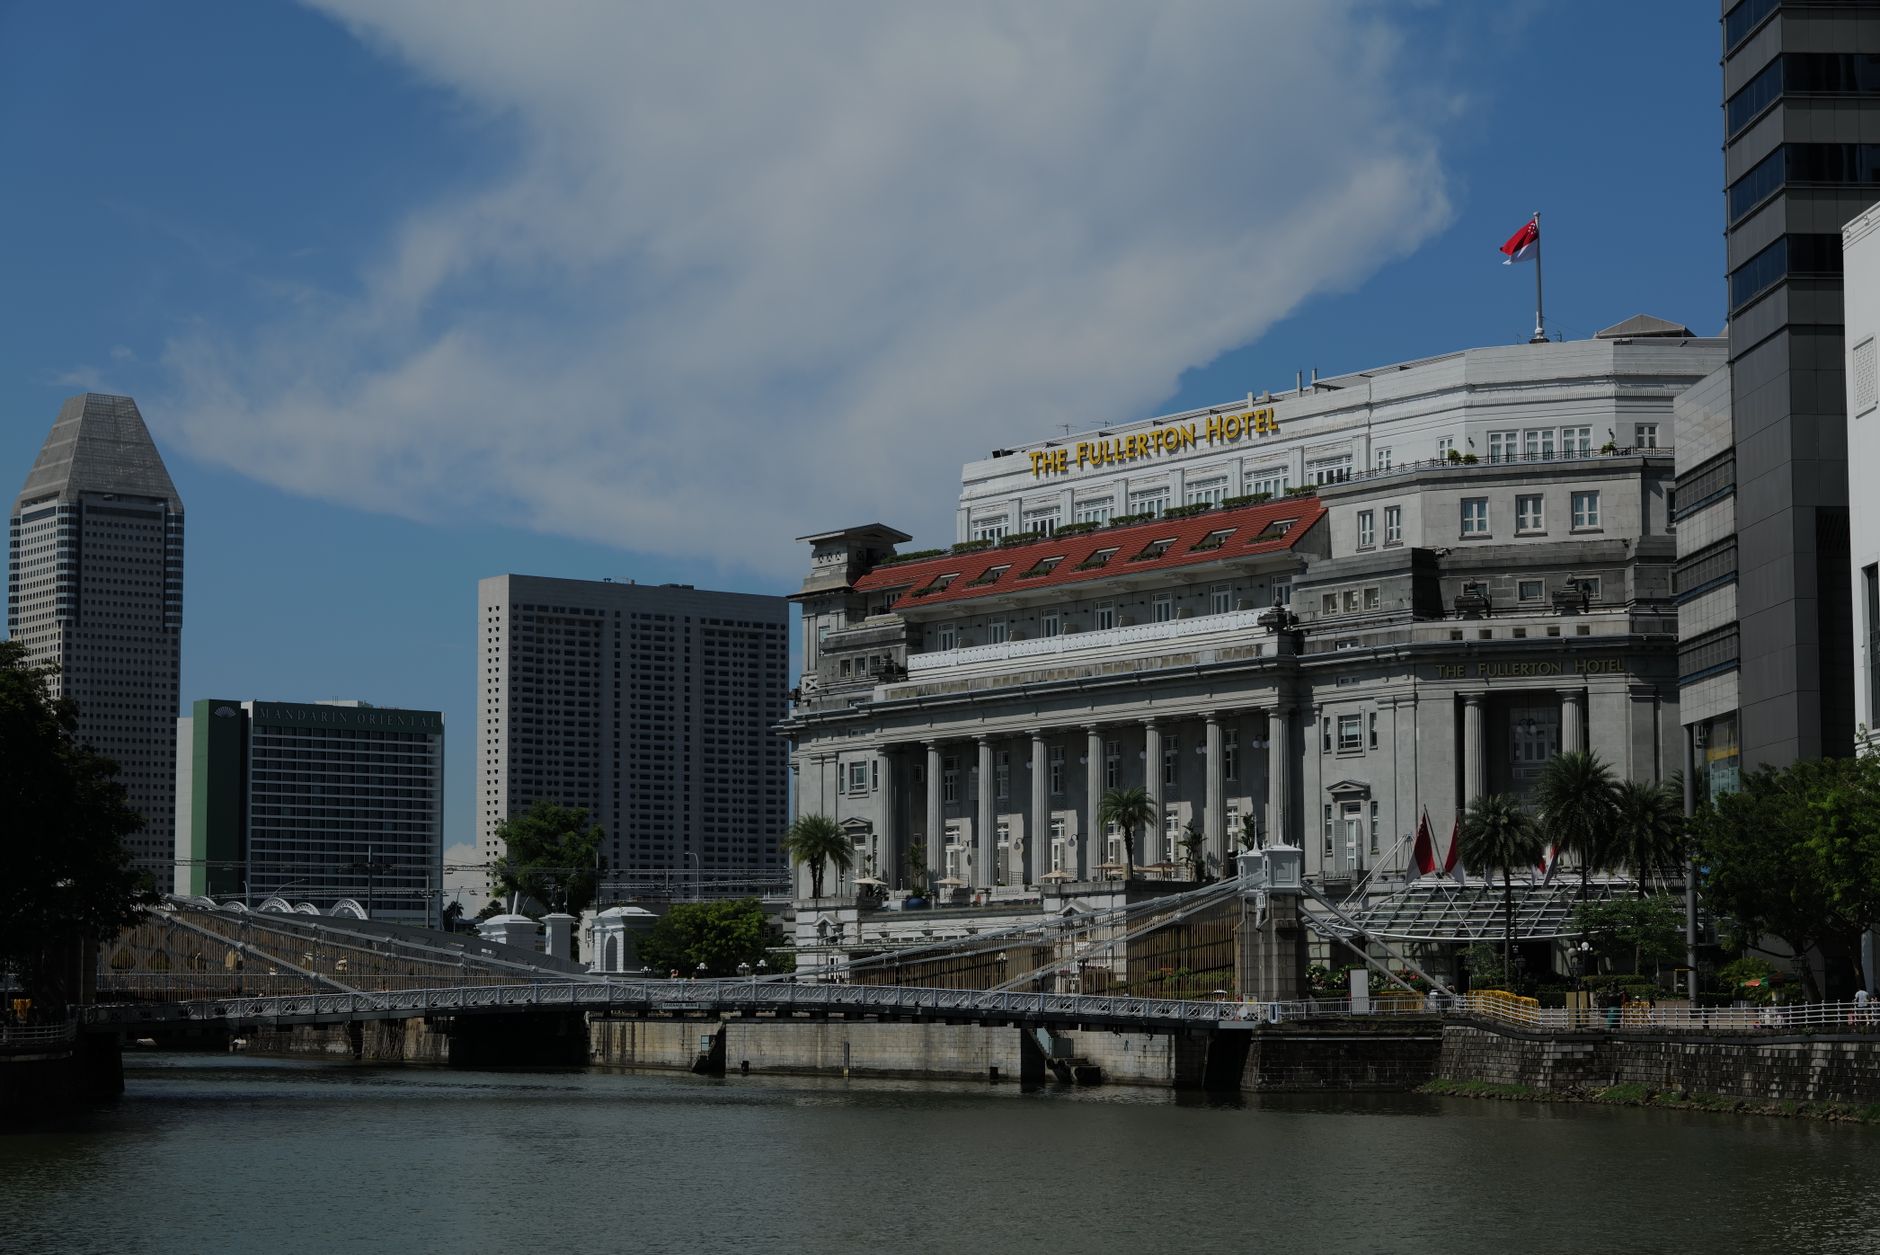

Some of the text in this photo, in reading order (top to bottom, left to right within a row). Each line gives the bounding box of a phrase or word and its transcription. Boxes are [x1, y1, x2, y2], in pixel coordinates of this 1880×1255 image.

[1029, 407, 1279, 476] THE FULLERTON HOTEL
[1435, 658, 1625, 679] THE FULLERTON HOTEL
[260, 708, 436, 728] MANDARIN ORIENTAL
